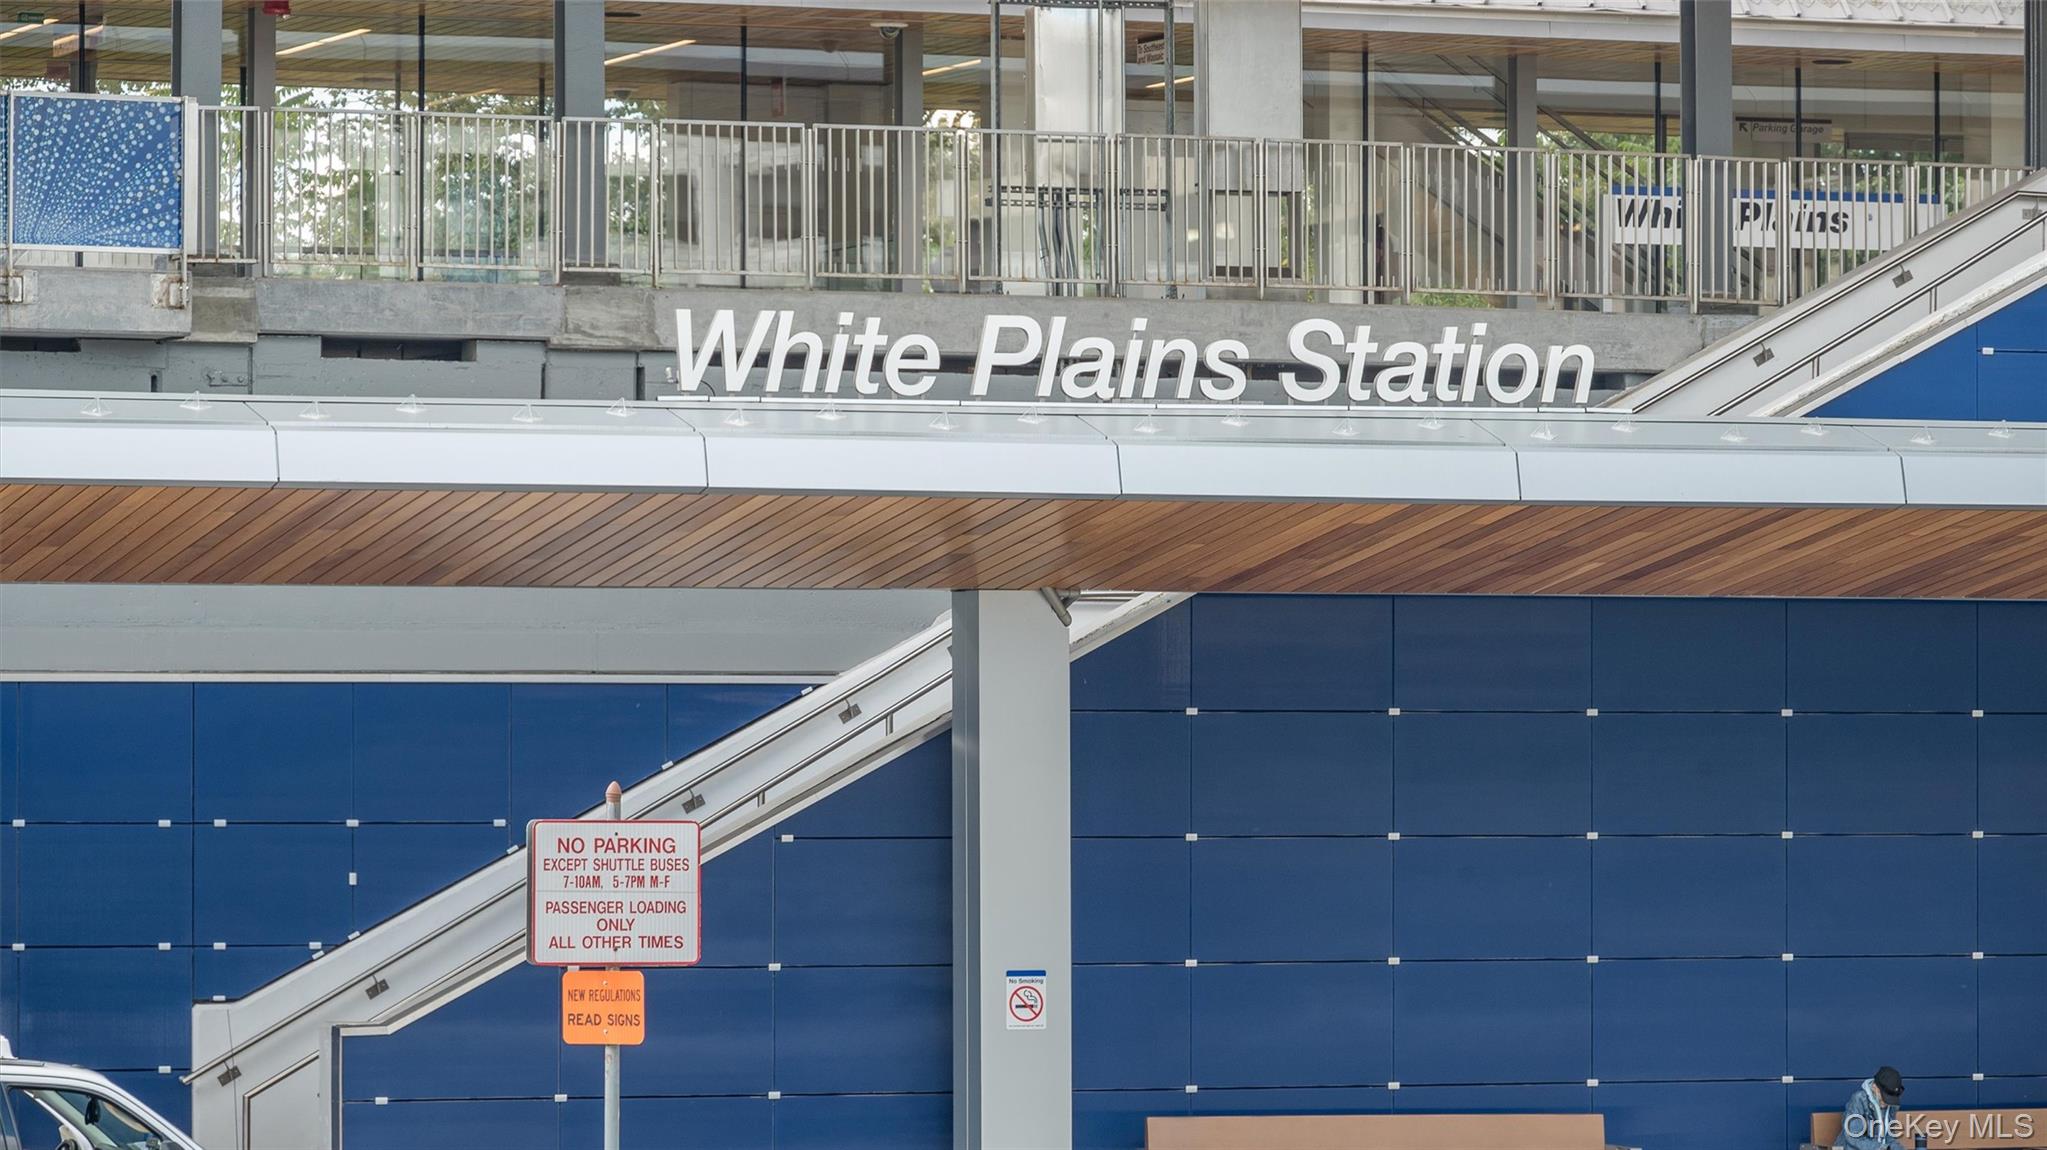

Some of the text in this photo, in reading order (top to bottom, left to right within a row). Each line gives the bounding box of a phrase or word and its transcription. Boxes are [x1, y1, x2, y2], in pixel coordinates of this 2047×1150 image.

[1752, 122, 1825, 136] Parking Grage
[1617, 198, 1682, 229] Whi
[675, 308, 1596, 405] White Plains Station
[557, 837, 676, 854] NO PARKING
[543, 858, 690, 872] EXCEPT SHUTTLE BUSES
[612, 875, 645, 889] 5-7PM
[650, 875, 671, 889] M-F
[545, 901, 687, 915] PASSENGER LOADING
[596, 918, 636, 932] ONLY
[548, 935, 684, 950] ALL OTHER TIMES
[567, 989, 641, 1002] NEW REGULATIONS
[567, 1013, 641, 1027] READ SIGNS
